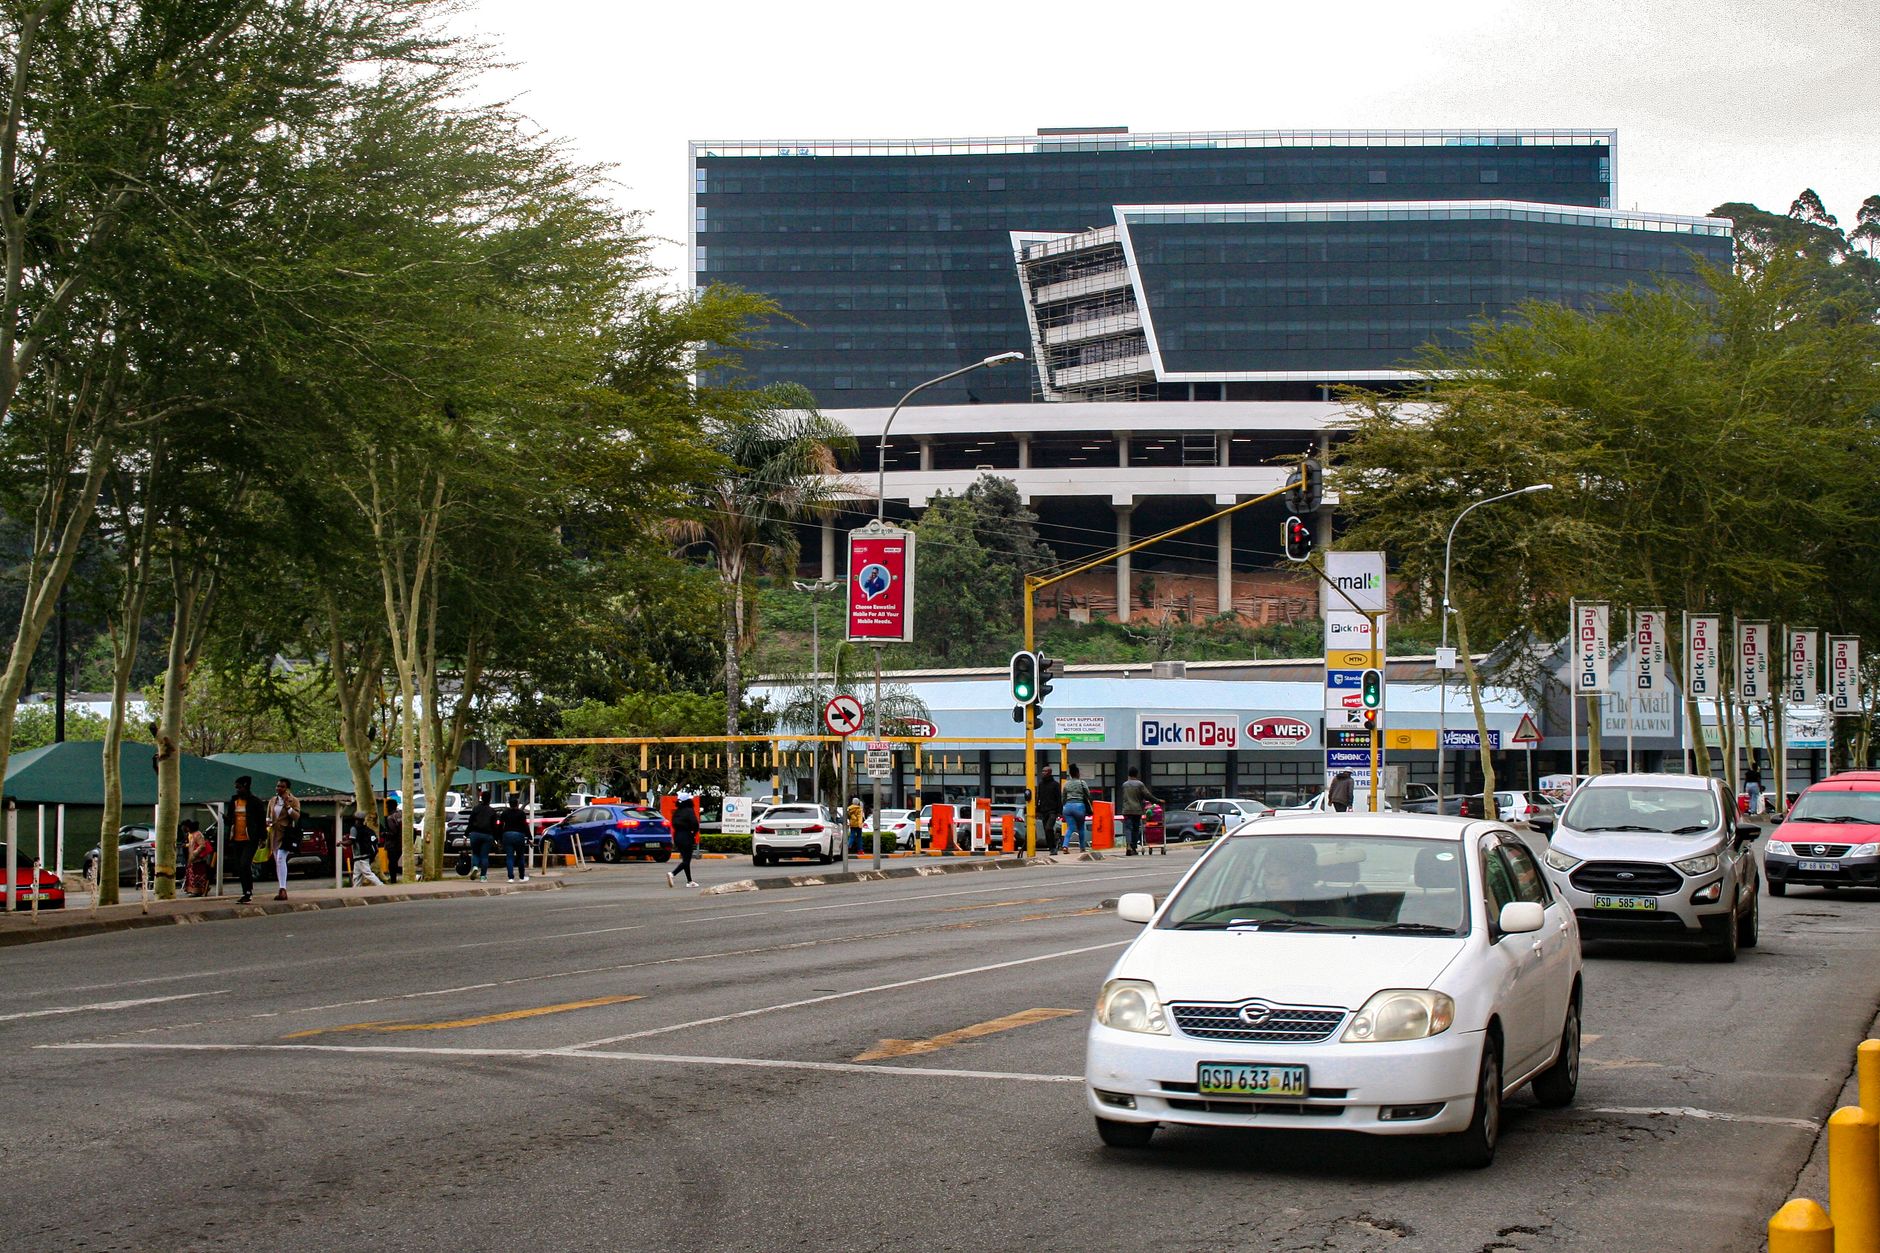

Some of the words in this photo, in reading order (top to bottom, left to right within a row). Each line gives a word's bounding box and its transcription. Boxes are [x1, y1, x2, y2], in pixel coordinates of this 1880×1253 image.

[1338, 573, 1371, 589] mall
[1331, 624, 1352, 633] Pick
[1360, 624, 1379, 633] Py
[1582, 609, 1596, 641] Pay
[1639, 614, 1653, 644] Pay
[1693, 621, 1707, 650] Pay
[1585, 643, 1593, 652] n
[1642, 647, 1650, 655] n
[1743, 627, 1757, 656] Pay
[1793, 635, 1806, 662] Pay
[1796, 664, 1803, 672] n
[1835, 643, 1847, 669] Pay
[1582, 653, 1596, 687] Pick
[1638, 657, 1652, 689] Pick
[1693, 663, 1706, 693] Pick
[1744, 667, 1756, 696] Pick
[1793, 673, 1805, 702] Pick
[1836, 680, 1847, 708] Pick
[1142, 721, 1182, 746] Pick
[1186, 727, 1195, 742] n
[1200, 721, 1236, 747] Pay
[1253, 724, 1307, 736] POWER
[1444, 731, 1498, 744] VISIONCRE
[1606, 718, 1670, 731] EMPALWINI
[1331, 752, 1381, 761] VISIONCAE
[1596, 896, 1611, 907] FSD
[1618, 897, 1634, 908] 585
[1644, 899, 1655, 908] CH
[1202, 1068, 1233, 1089] QSD
[1239, 1069, 1269, 1090] 633
[1281, 1071, 1302, 1091] AM
